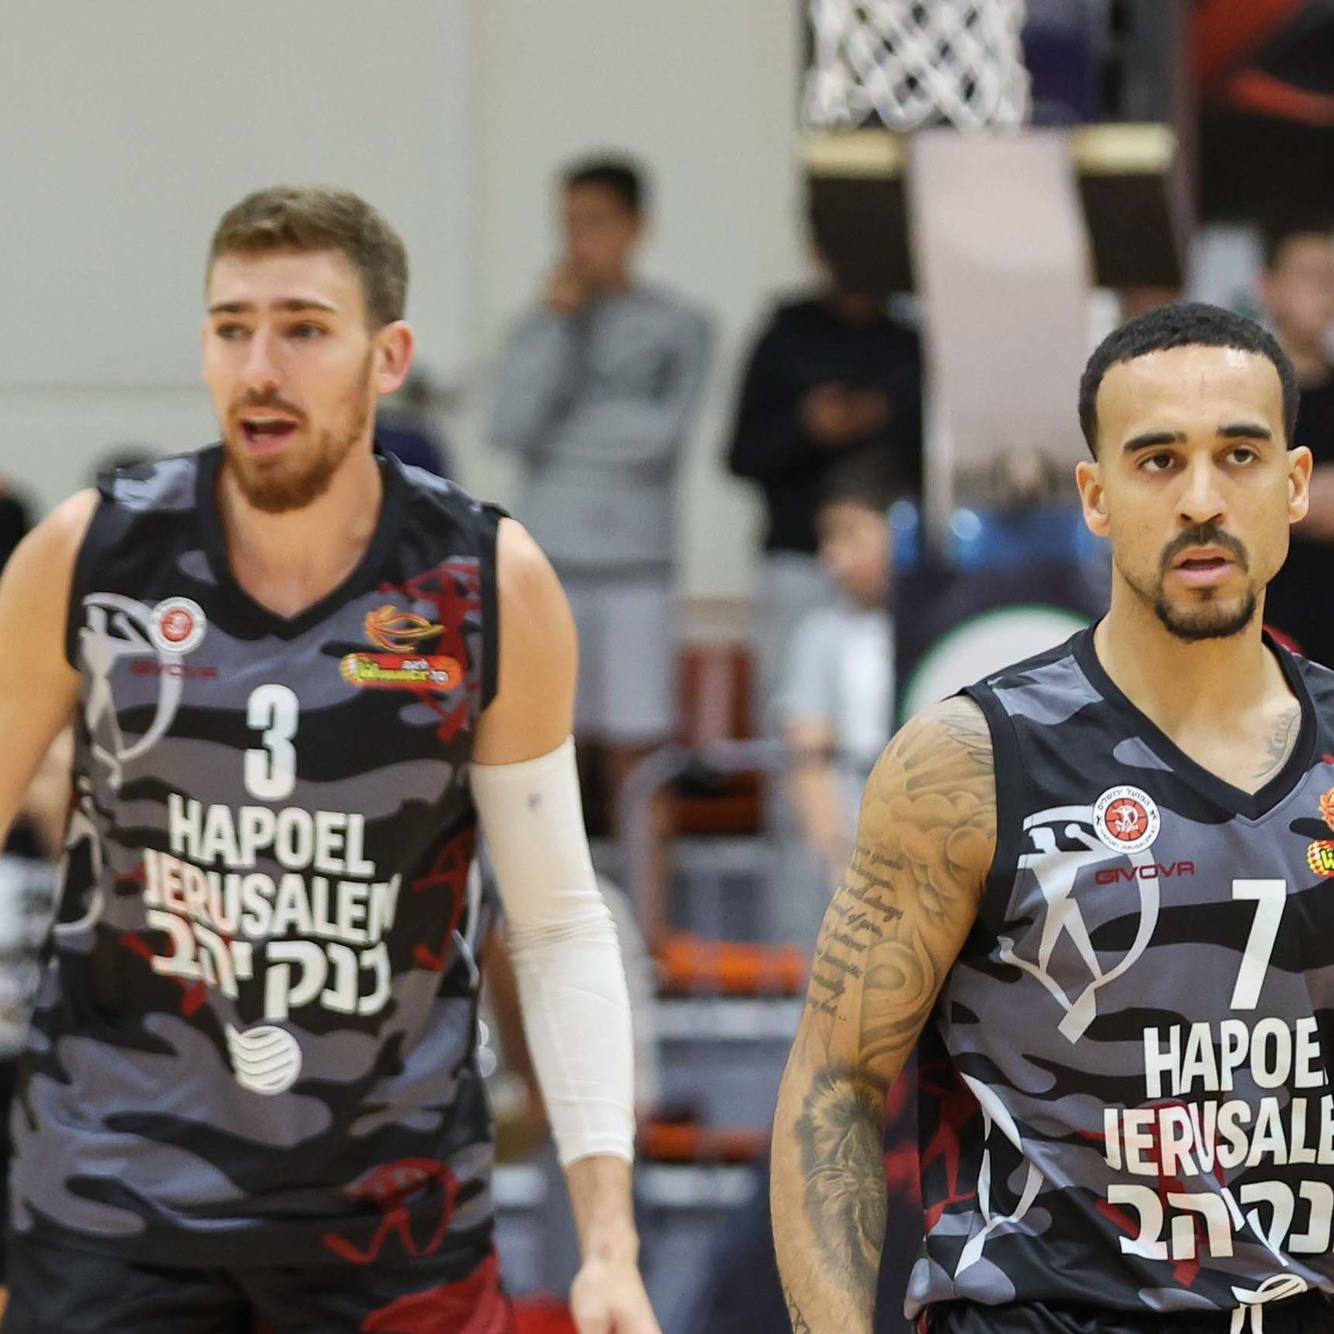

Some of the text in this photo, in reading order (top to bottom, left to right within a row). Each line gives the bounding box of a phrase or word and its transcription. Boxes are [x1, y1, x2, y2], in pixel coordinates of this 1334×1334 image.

[244, 684, 298, 801] 3
[168, 793, 375, 878] HAPOEL
[1095, 861, 1195, 885] GIVOVA
[1229, 879, 1286, 1010] 7
[1143, 1016, 1329, 1098] HAPOE
